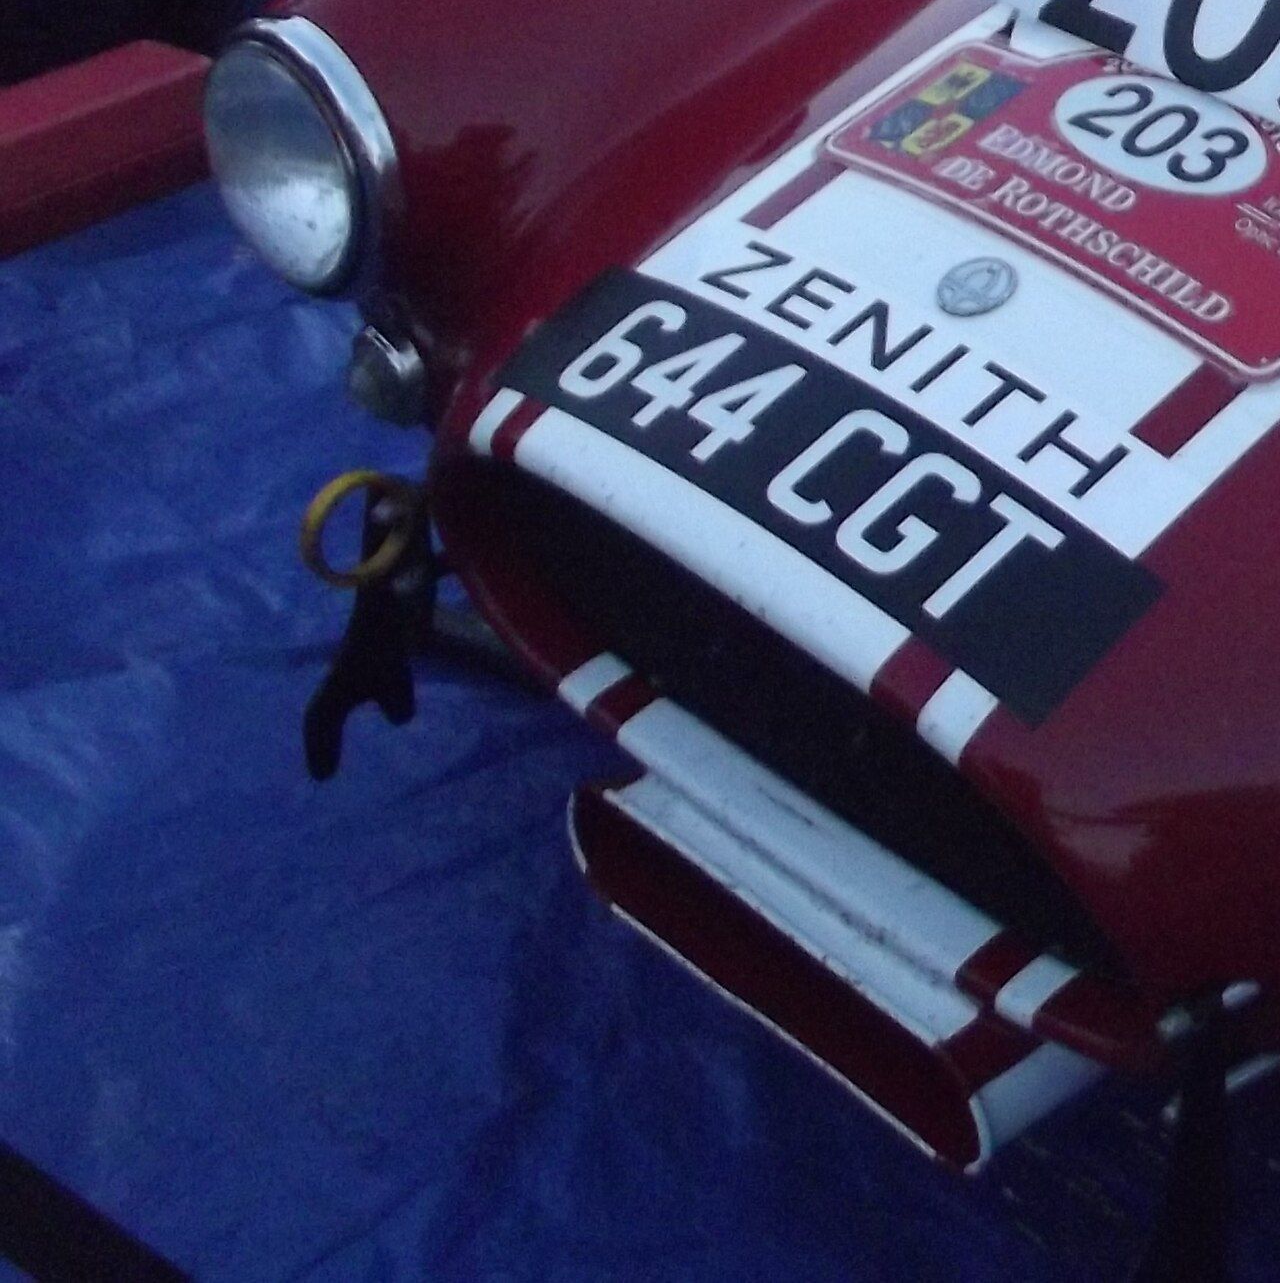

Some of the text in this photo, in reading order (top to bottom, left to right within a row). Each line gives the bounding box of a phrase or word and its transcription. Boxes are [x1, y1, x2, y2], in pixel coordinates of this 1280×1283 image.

[976, 123, 1137, 212] EDMOND
[1067, 80, 1252, 184] 203
[938, 156, 1233, 323] DE ROTHSCHILD
[700, 240, 1130, 500] ZENITH
[558, 299, 1067, 620] 644 CGT
